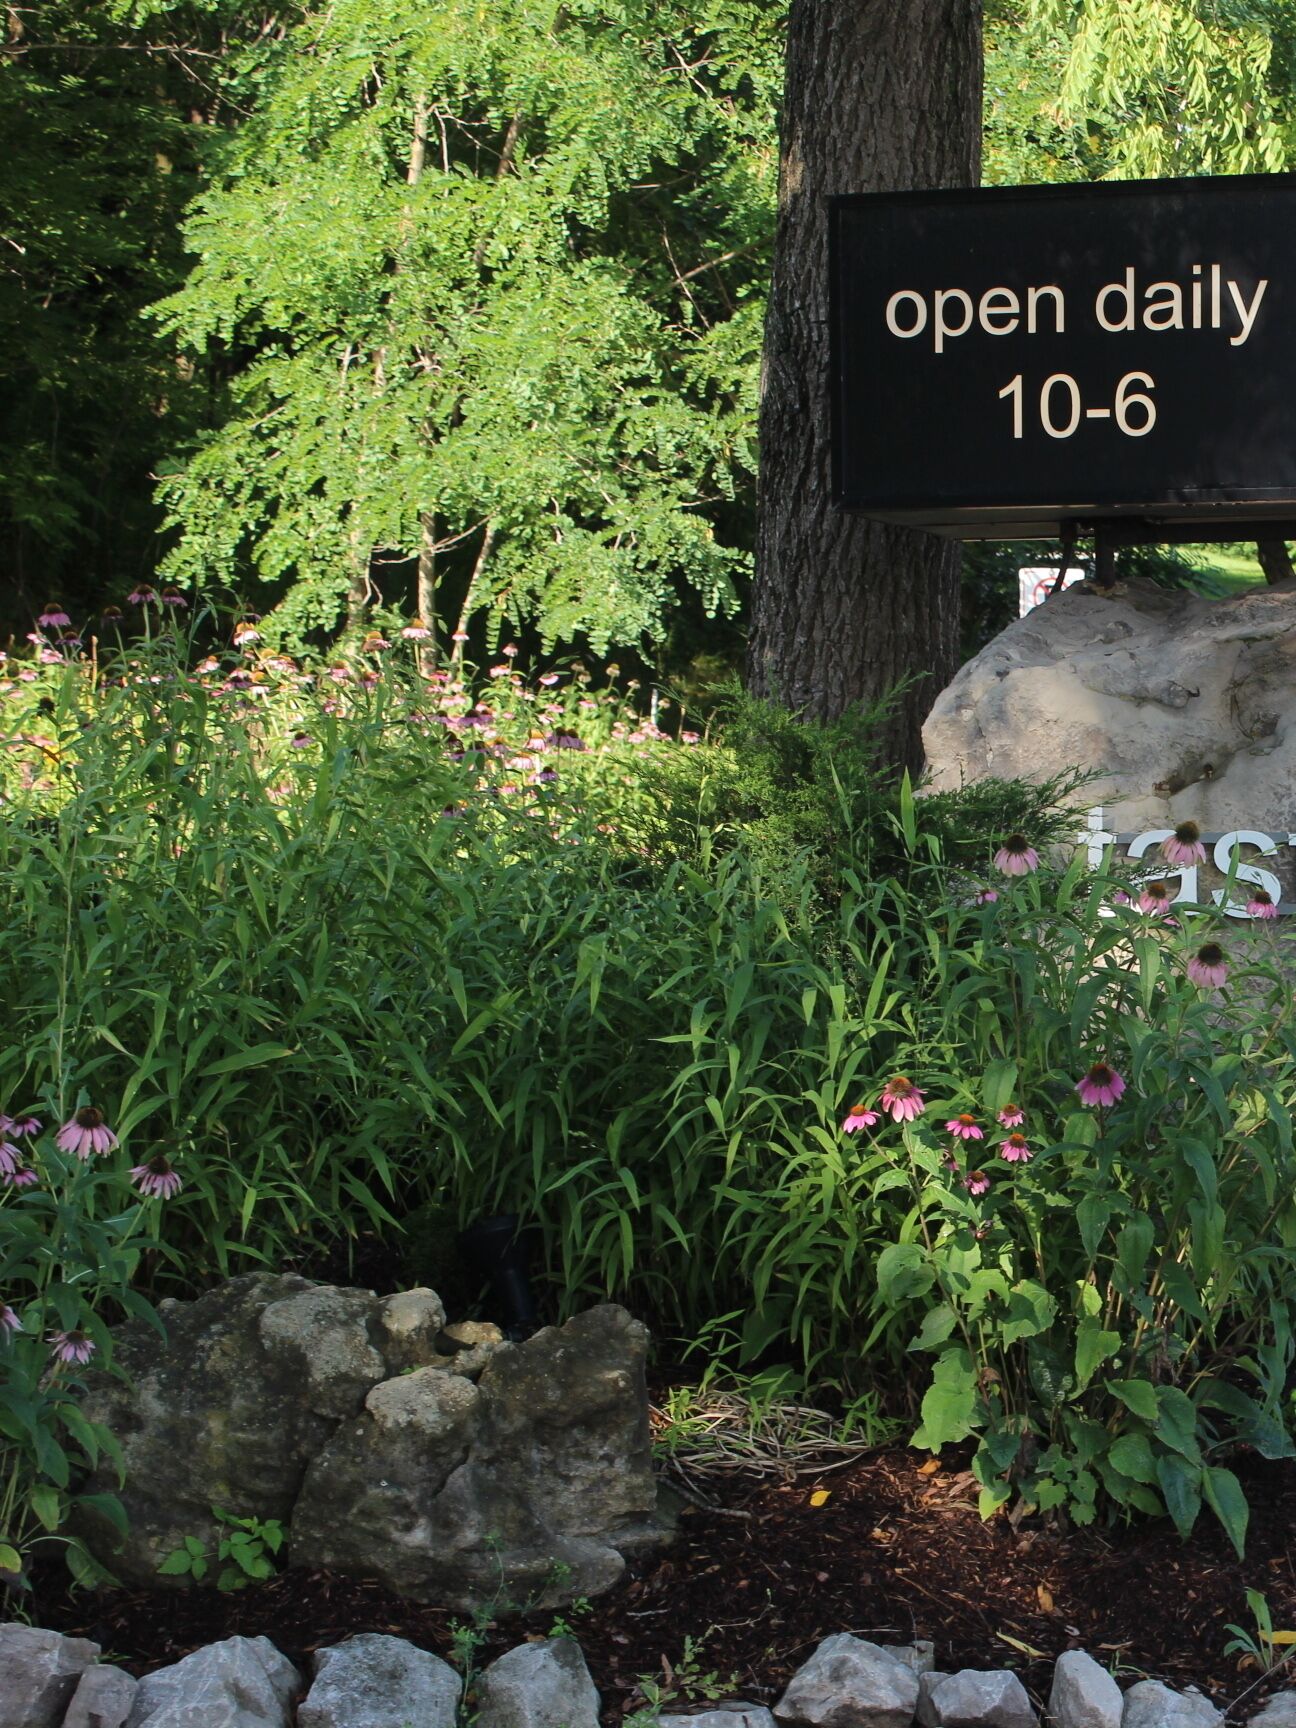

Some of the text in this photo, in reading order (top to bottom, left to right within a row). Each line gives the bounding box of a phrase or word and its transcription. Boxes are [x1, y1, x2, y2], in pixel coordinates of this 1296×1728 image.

[886, 264, 1268, 354] open daily
[998, 371, 1157, 439] 10-6
